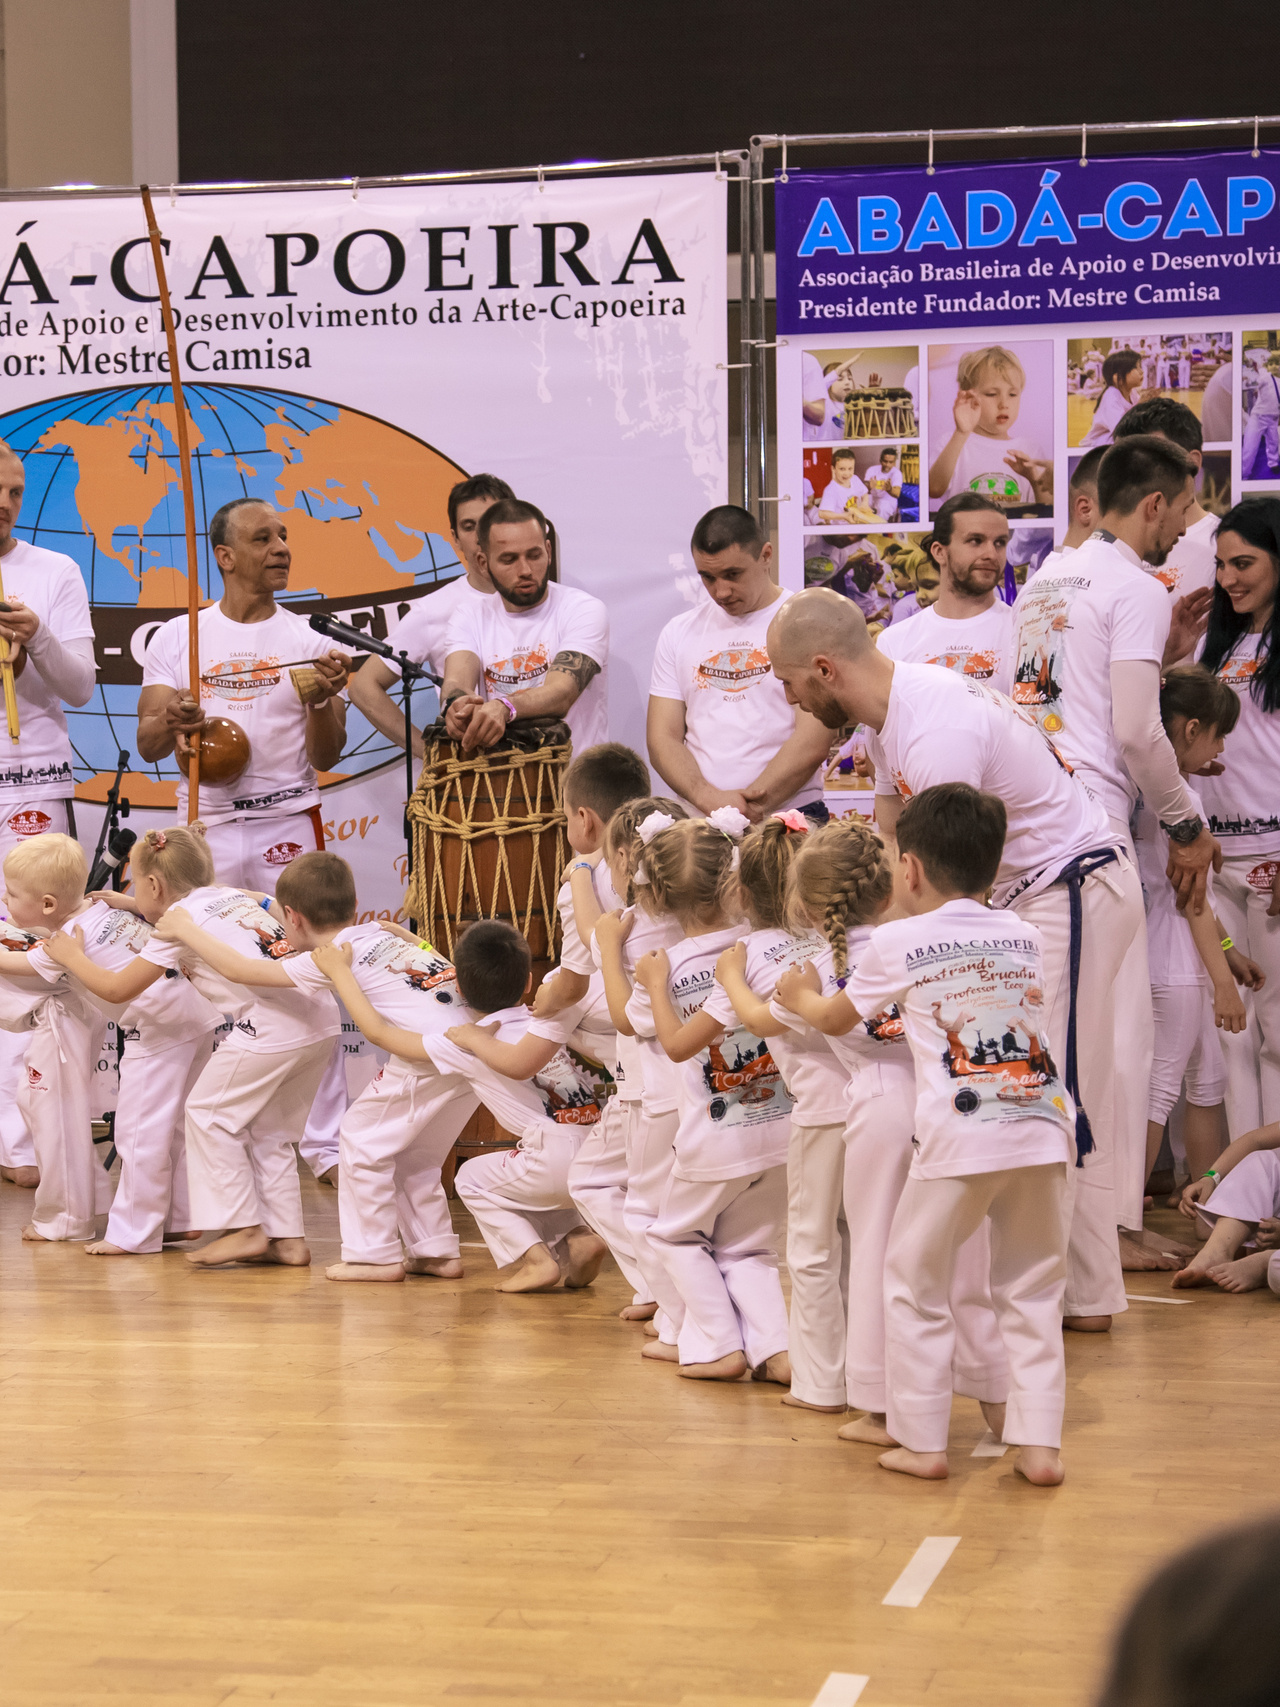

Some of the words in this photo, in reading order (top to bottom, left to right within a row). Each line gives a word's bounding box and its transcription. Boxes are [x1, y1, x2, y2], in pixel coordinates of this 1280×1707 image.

[797, 168, 1280, 257] ABADÁ-CAP
[799, 265, 914, 288] Associação
[920, 260, 1021, 282] Brasileira
[1027, 257, 1053, 277] de
[1060, 254, 1127, 280] Apoio
[1133, 259, 1145, 272] e
[38, 309, 125, 343] Apoio
[135, 316, 149, 333] e
[159, 302, 418, 333] Desenvolvimento
[428, 298, 462, 325] da
[472, 290, 687, 327] Arte-Capoeira
[799, 296, 917, 319] Presidente
[924, 290, 1041, 314] Fundador:
[1047, 287, 1128, 309] Mestre
[1134, 281, 1221, 304] Camisa
[57, 344, 171, 375] Mestre
[185, 337, 312, 372] Camisa
